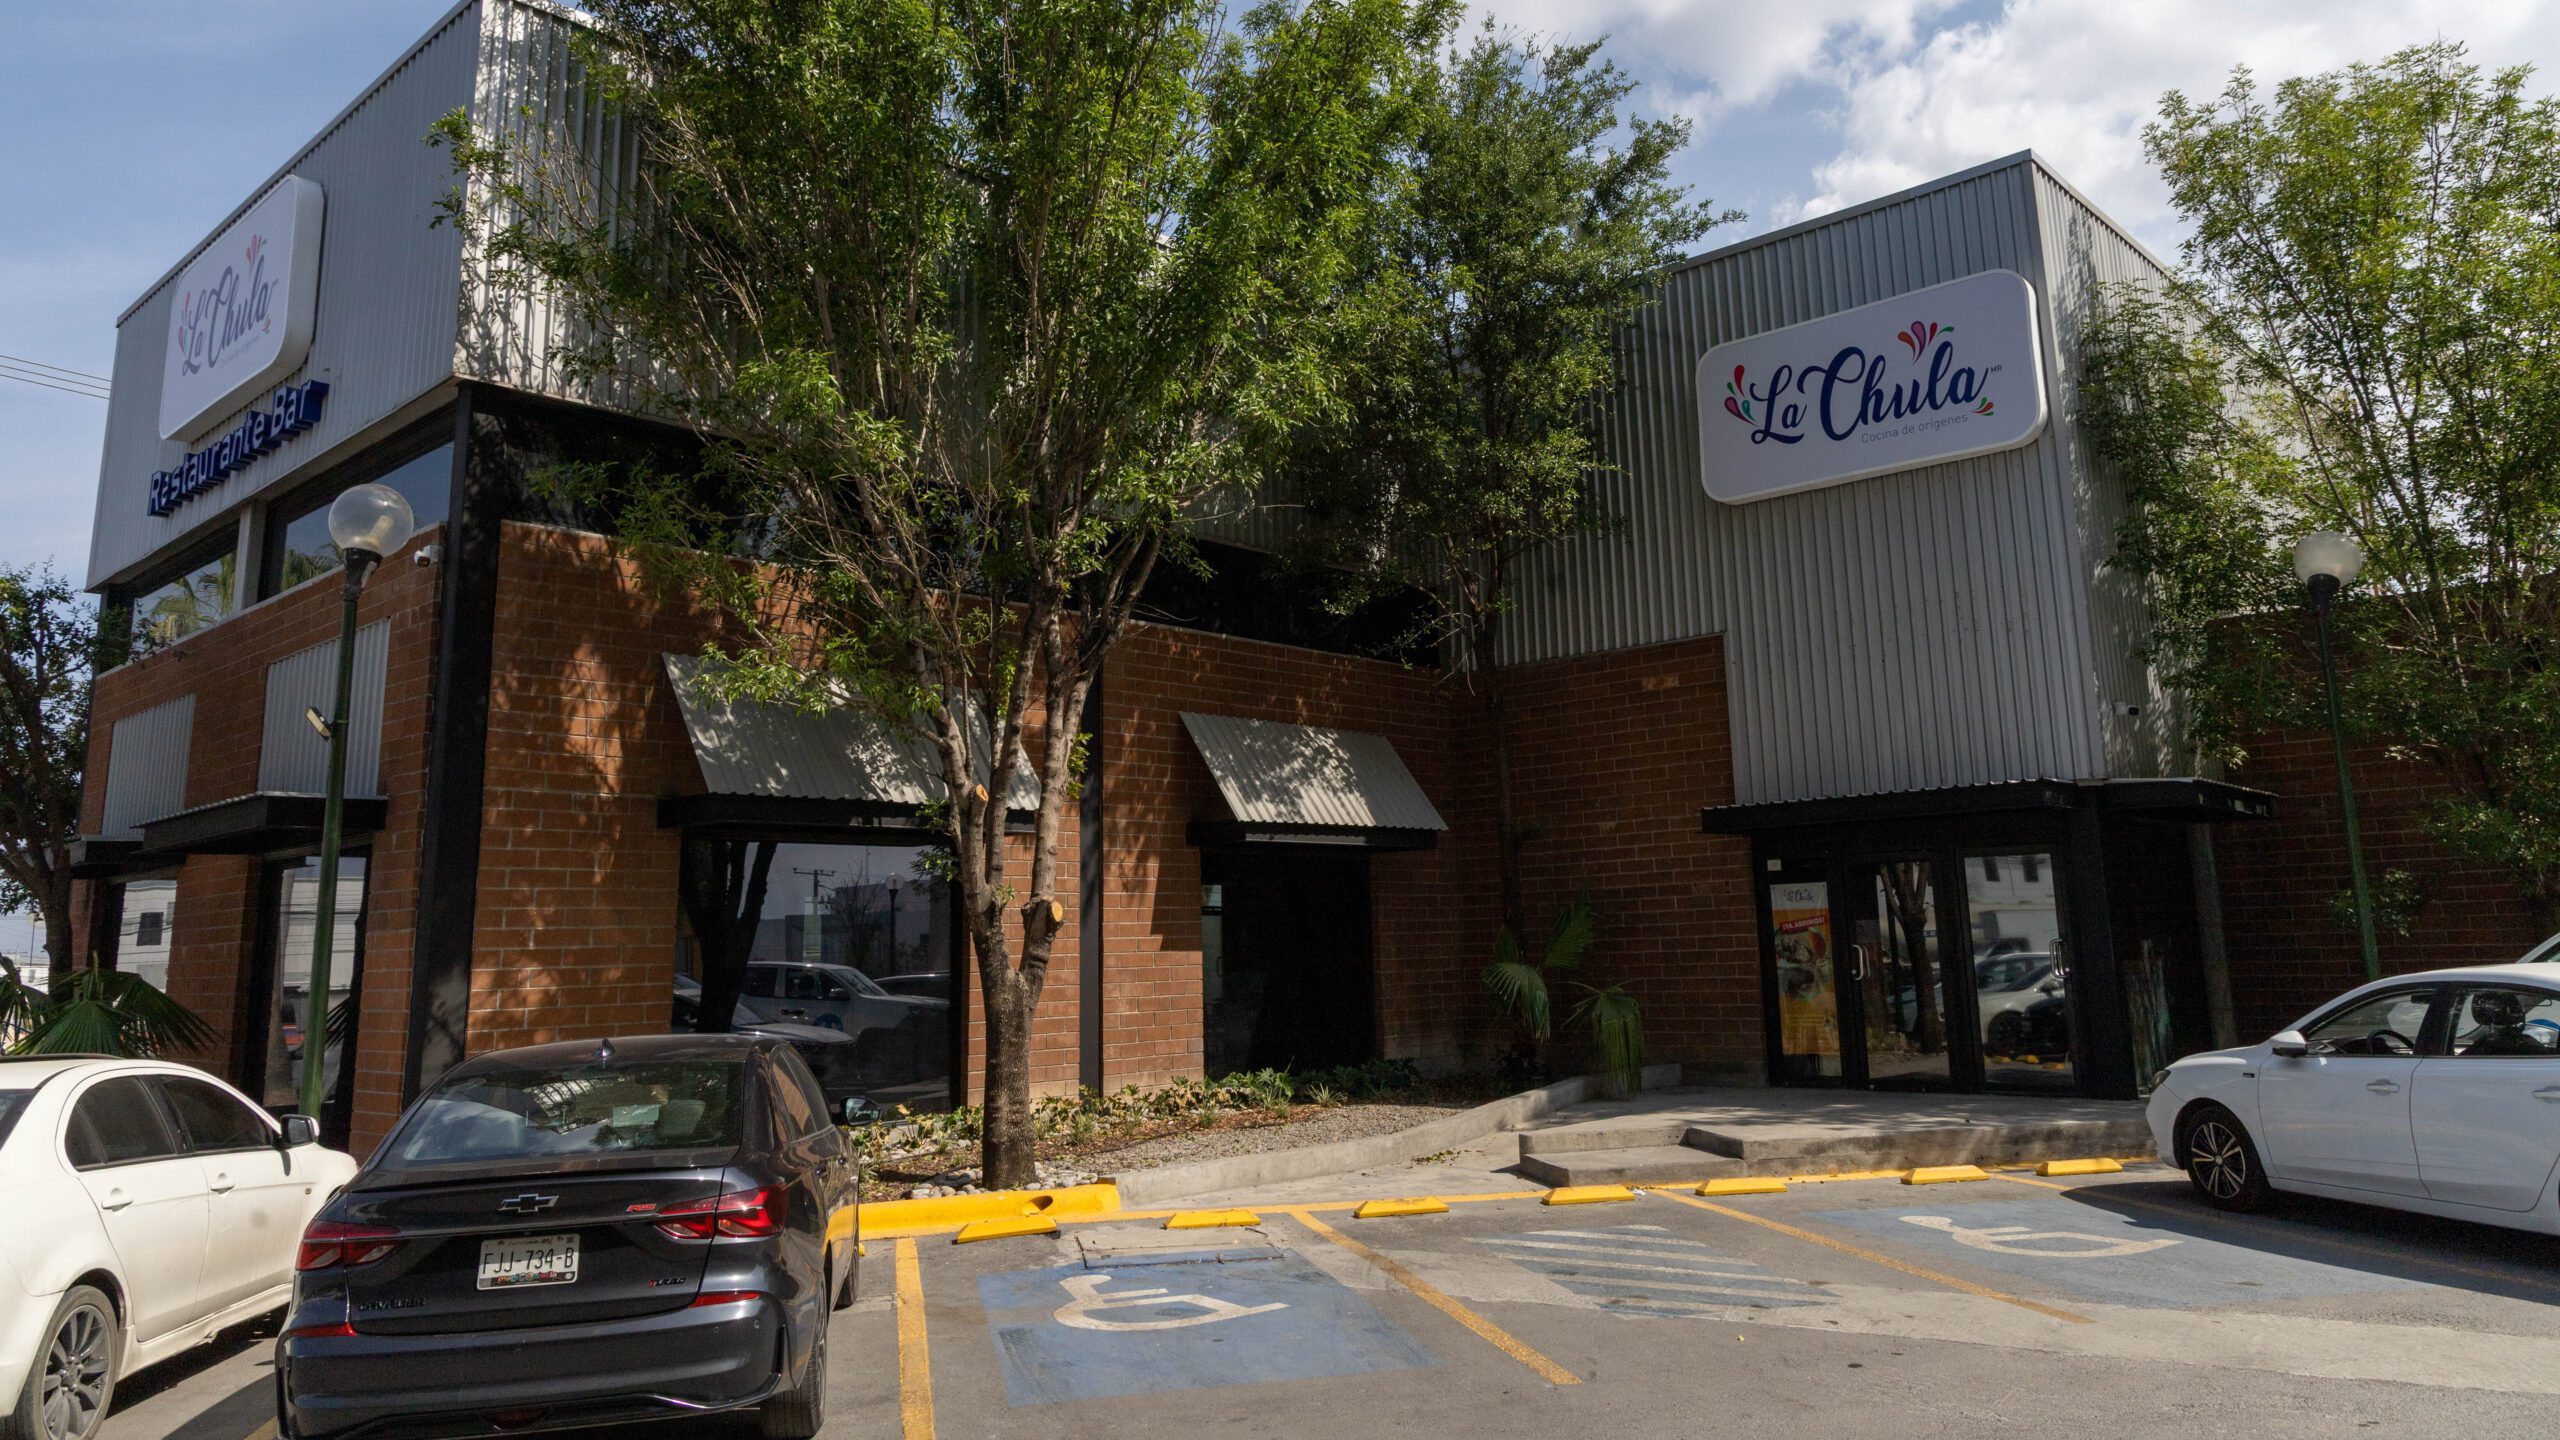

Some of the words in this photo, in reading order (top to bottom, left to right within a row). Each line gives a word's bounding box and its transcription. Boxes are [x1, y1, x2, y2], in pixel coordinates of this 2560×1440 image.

[182, 289, 207, 377] La
[206, 255, 272, 368] Chula
[1749, 364, 1808, 445] La
[1797, 340, 1990, 441] Chula
[1861, 428, 1899, 444] Cocina
[1902, 424, 1916, 436] de
[1918, 413, 1969, 433] orígenes
[148, 410, 271, 516] Restaurante
[271, 379, 320, 440] Bar
[482, 1247, 575, 1275] FJJ-734-B
